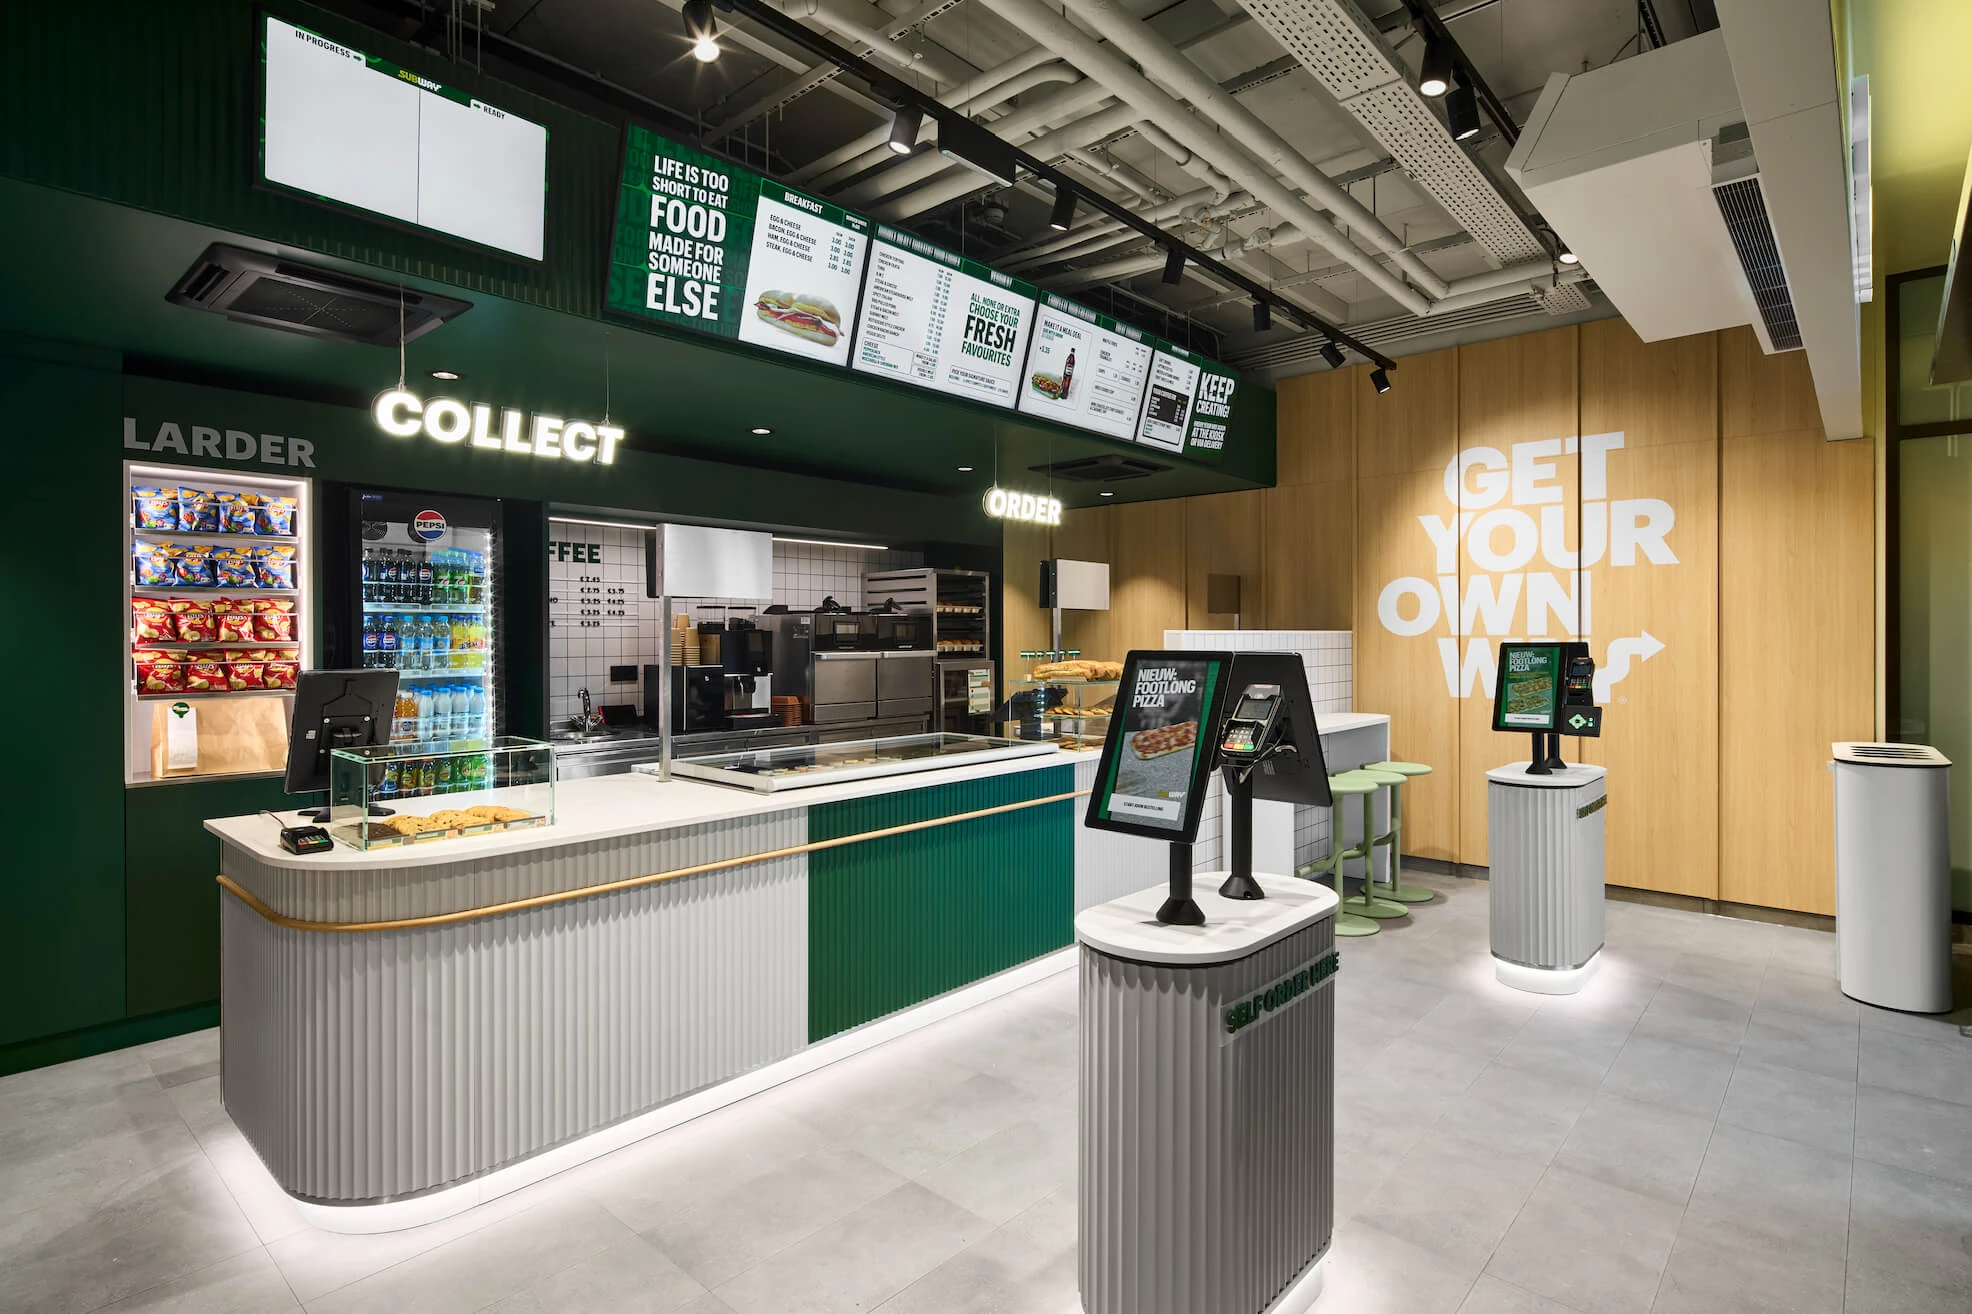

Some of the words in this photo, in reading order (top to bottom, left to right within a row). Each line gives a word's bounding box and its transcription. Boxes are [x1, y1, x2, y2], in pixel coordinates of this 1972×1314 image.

[295, 30, 305, 41] IN
[306, 32, 351, 59] PROGRESS
[398, 69, 443, 93] SUBWAY
[483, 105, 506, 120] READY
[653, 154, 683, 179] LIFE
[685, 163, 699, 184] IS
[701, 169, 729, 193] TOO
[652, 175, 692, 200] SHORT
[692, 186, 707, 204] TO
[708, 191, 729, 210] EAT
[784, 191, 824, 215] BREAKFAST
[650, 193, 727, 243] FOOD
[770, 214, 780, 222] EGG
[784, 220, 801, 231] CHEESE
[648, 230, 694, 259] MADE
[695, 242, 724, 267] FOR
[780, 236, 789, 245] EGG
[793, 241, 811, 253] CHEESE
[787, 229, 796, 238] EGG
[800, 235, 817, 246] CHEESE
[648, 251, 722, 285] SOMEONE
[782, 247, 792, 255] EGG
[796, 252, 813, 263] CHEESE
[646, 272, 720, 322] ELSE
[982, 296, 996, 310] NONE
[997, 302, 1004, 312] OR
[1004, 304, 1020, 317] EXTRA
[969, 302, 999, 322] CHOOSE
[1000, 312, 1019, 329] YOUR
[964, 314, 1016, 353] FRESH
[961, 340, 1012, 368] FAVOURITES
[1199, 371, 1236, 405] KEEP
[1196, 400, 1230, 418] CREATING!
[374, 389, 625, 465] COLLECT
[1209, 429, 1225, 442] KIOSK
[123, 416, 317, 468] LARDER
[1443, 431, 1625, 510] GET
[986, 487, 1063, 525] ORDER
[416, 521, 445, 529] PEPSI
[1417, 498, 1680, 573] YOUR
[1377, 570, 1592, 637] OWN
[1509, 664, 1529, 672] PIZZA
[1510, 651, 1534, 659] NIEUW:
[1134, 679, 1197, 696] FOOTLONG
[1137, 668, 1177, 682] NIEUW:
[1132, 694, 1165, 708] PIZZA
[1263, 968, 1310, 1015] ORDER
